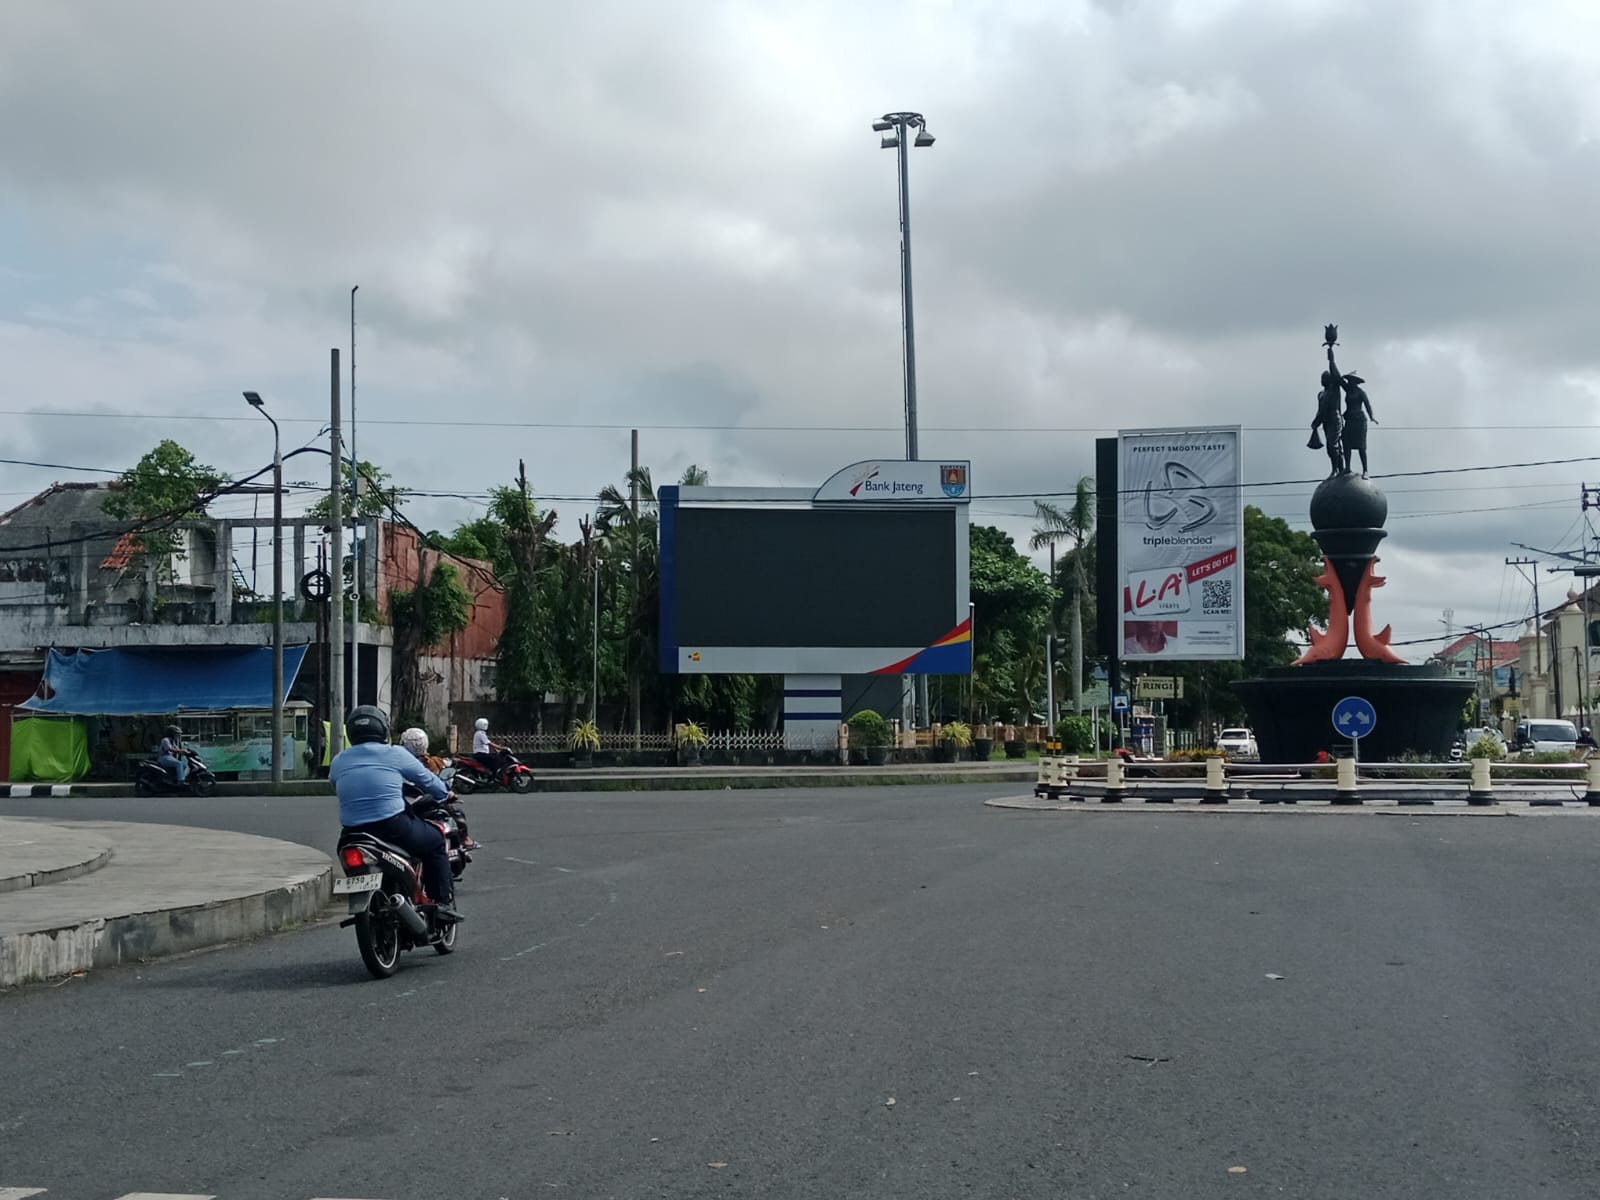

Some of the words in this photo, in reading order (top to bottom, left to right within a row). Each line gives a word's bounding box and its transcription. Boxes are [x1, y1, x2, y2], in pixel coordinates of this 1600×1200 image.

[865, 480, 890, 491] Bank
[892, 481, 924, 494] Jateng
[1192, 564, 1211, 577] LET'S
[382, 852, 405, 872] HONDA
